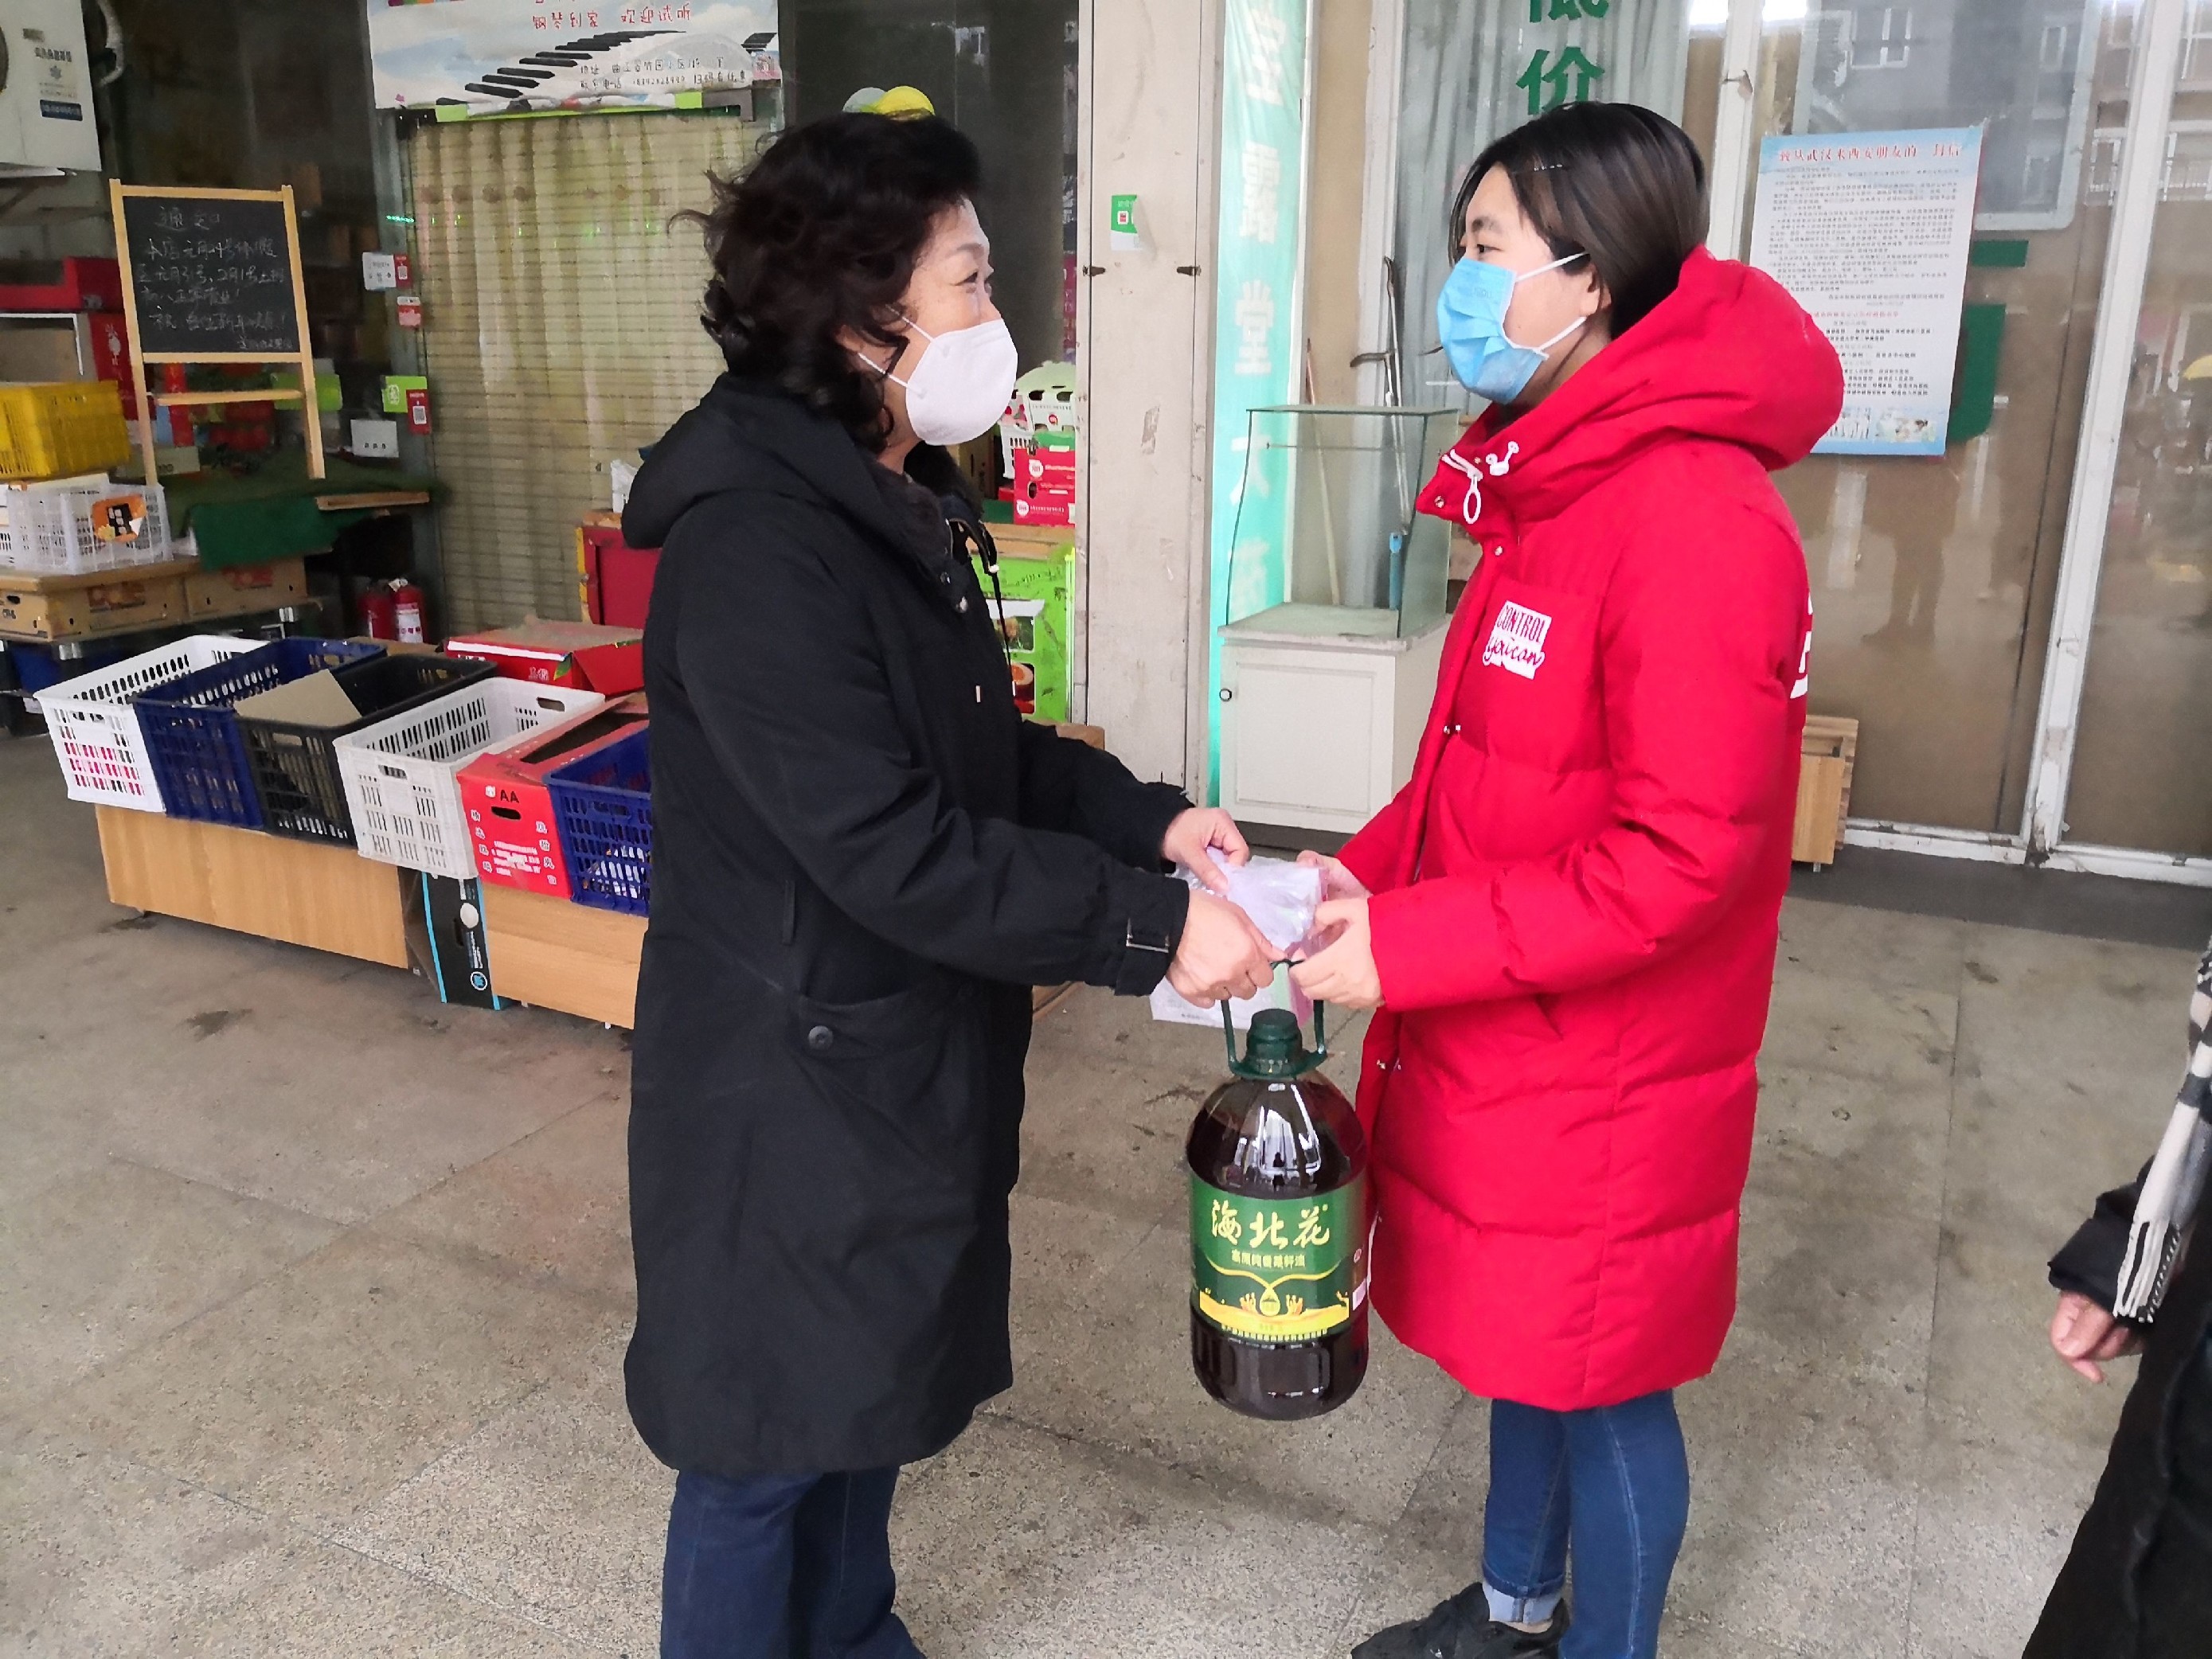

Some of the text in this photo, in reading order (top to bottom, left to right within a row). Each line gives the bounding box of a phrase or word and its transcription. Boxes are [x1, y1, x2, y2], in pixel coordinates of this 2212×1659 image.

[532, 2, 692, 30] 钢琴到家 欢迎试听
[1496, 604, 1546, 642] CONTROL
[500, 789, 520, 803] AA
[1211, 1199, 1330, 1250] 海北花
